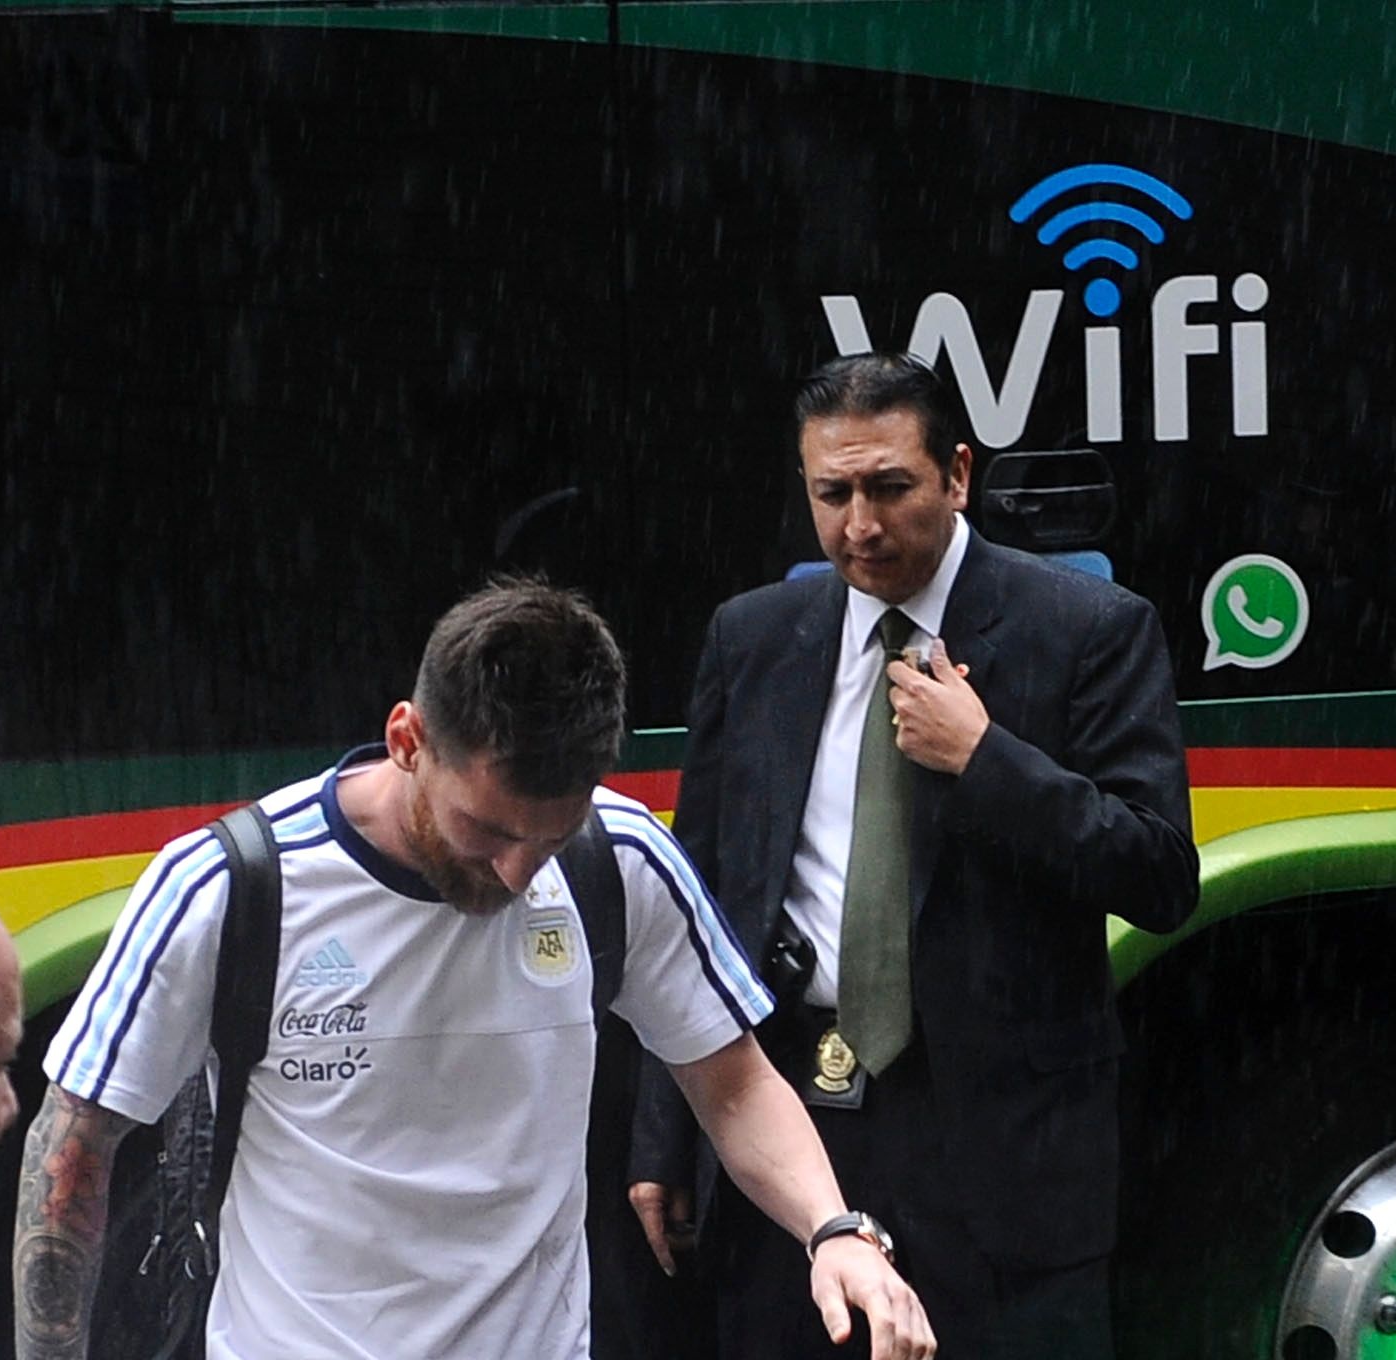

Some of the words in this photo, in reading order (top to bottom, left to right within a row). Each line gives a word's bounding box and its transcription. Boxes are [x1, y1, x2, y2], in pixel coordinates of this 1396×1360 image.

[820, 273, 1269, 449] Wifi
[295, 968, 370, 988] adidas
[279, 1002, 368, 1038] Coca-Cola
[280, 1058, 357, 1082] Claro
